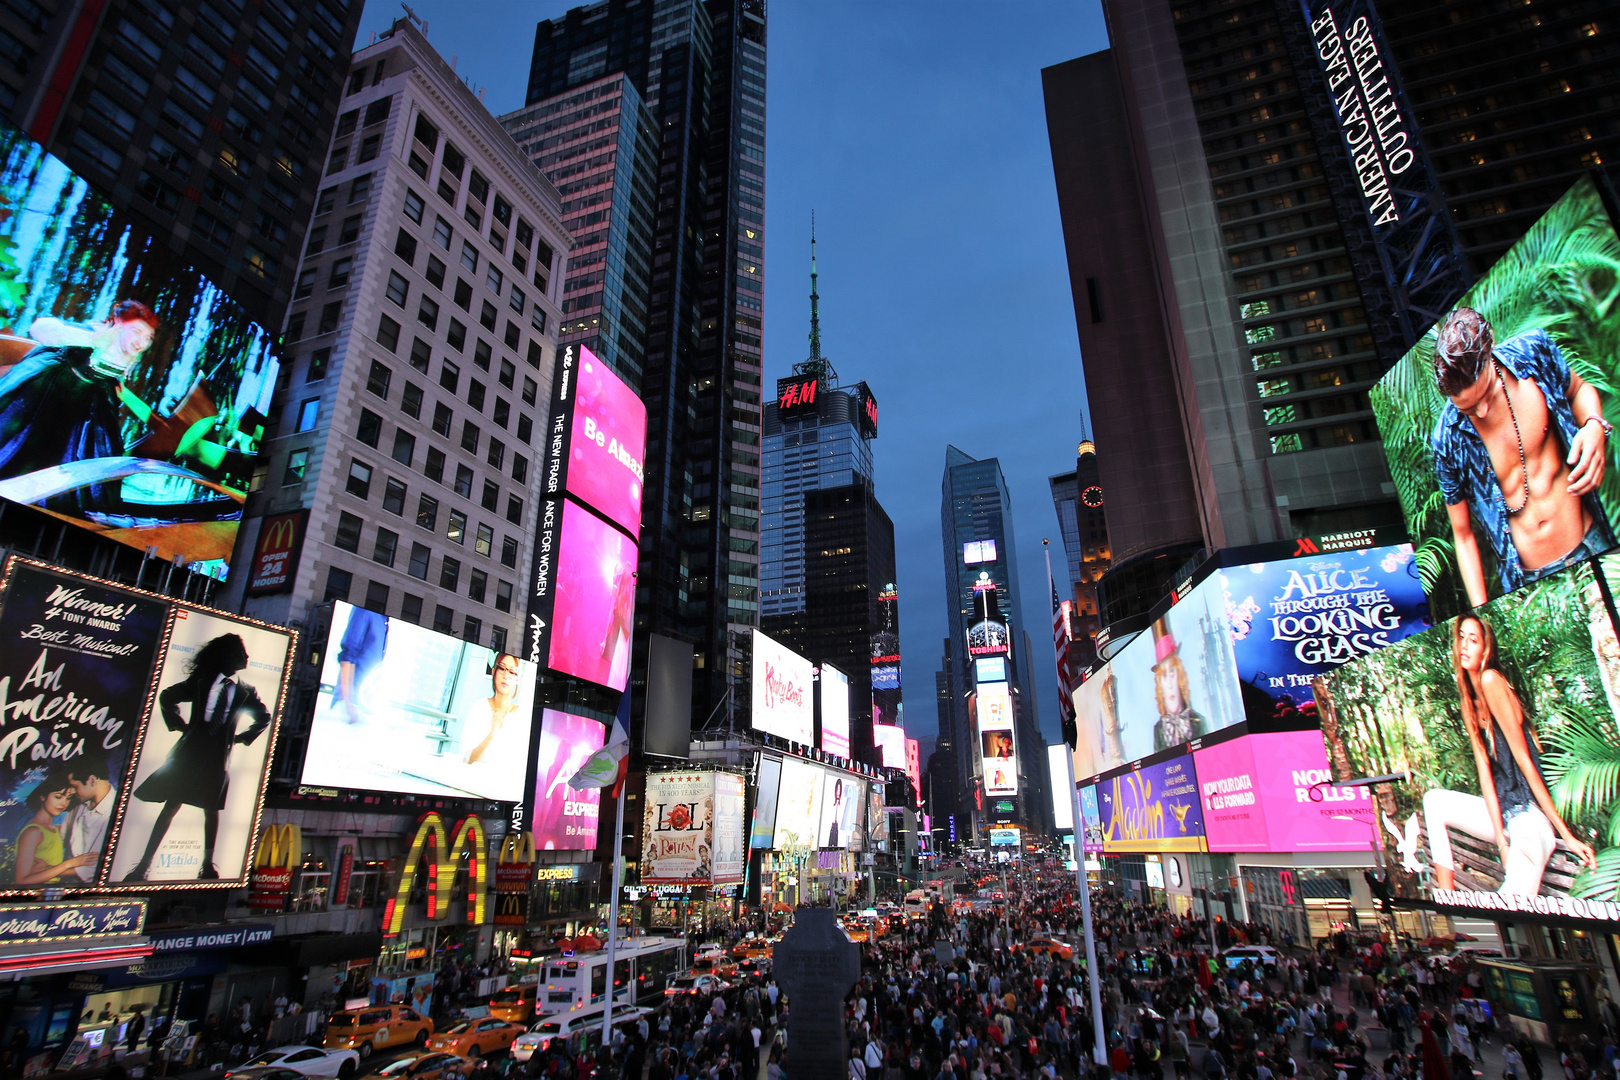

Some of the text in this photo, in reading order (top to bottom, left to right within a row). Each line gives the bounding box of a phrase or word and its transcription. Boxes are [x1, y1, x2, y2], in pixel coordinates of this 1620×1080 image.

[1345, 16, 1414, 175] OUTFITTERS
[1311, 7, 1399, 228] AMERICAN EAGLE
[779, 379, 817, 409] H&M
[554, 413, 565, 434] THE
[866, 395, 877, 429] H&M
[584, 416, 605, 447] Be
[552, 435, 562, 457] NEW
[540, 530, 553, 554] FOR
[1320, 529, 1376, 543] MARRIOTT
[1322, 537, 1373, 551] MARQUIS
[262, 551, 288, 562] OPEN
[252, 575, 286, 587] HOURS
[261, 561, 283, 577] 24
[537, 554, 550, 597] WOMEN
[45, 584, 137, 621] Winner!
[1269, 589, 1391, 616] THROUGH THE
[45, 607, 121, 632] 4 TONY AWARDS
[20, 624, 70, 643] Best
[70, 633, 139, 656] Musical!
[970, 644, 1008, 655] TOSHIBA
[17, 648, 65, 692] An
[1269, 673, 1314, 688] IN THE
[1203, 774, 1253, 796] NOW YOUR DATA
[1101, 770, 1165, 842] Aladdin
[1225, 791, 1255, 808] FORWARD
[512, 801, 524, 831] NEW
[654, 802, 704, 832] LOL
[565, 825, 576, 836] Be
[156, 853, 199, 869] Matilda
[496, 867, 532, 875] McDonald's
[537, 868, 574, 881] EXPRESS
[1432, 887, 1510, 912] AMERICAN
[1507, 893, 1565, 916] EAGLE
[55, 909, 97, 935] Paris
[196, 933, 242, 947] MONEY
[247, 930, 272, 943] ATM
